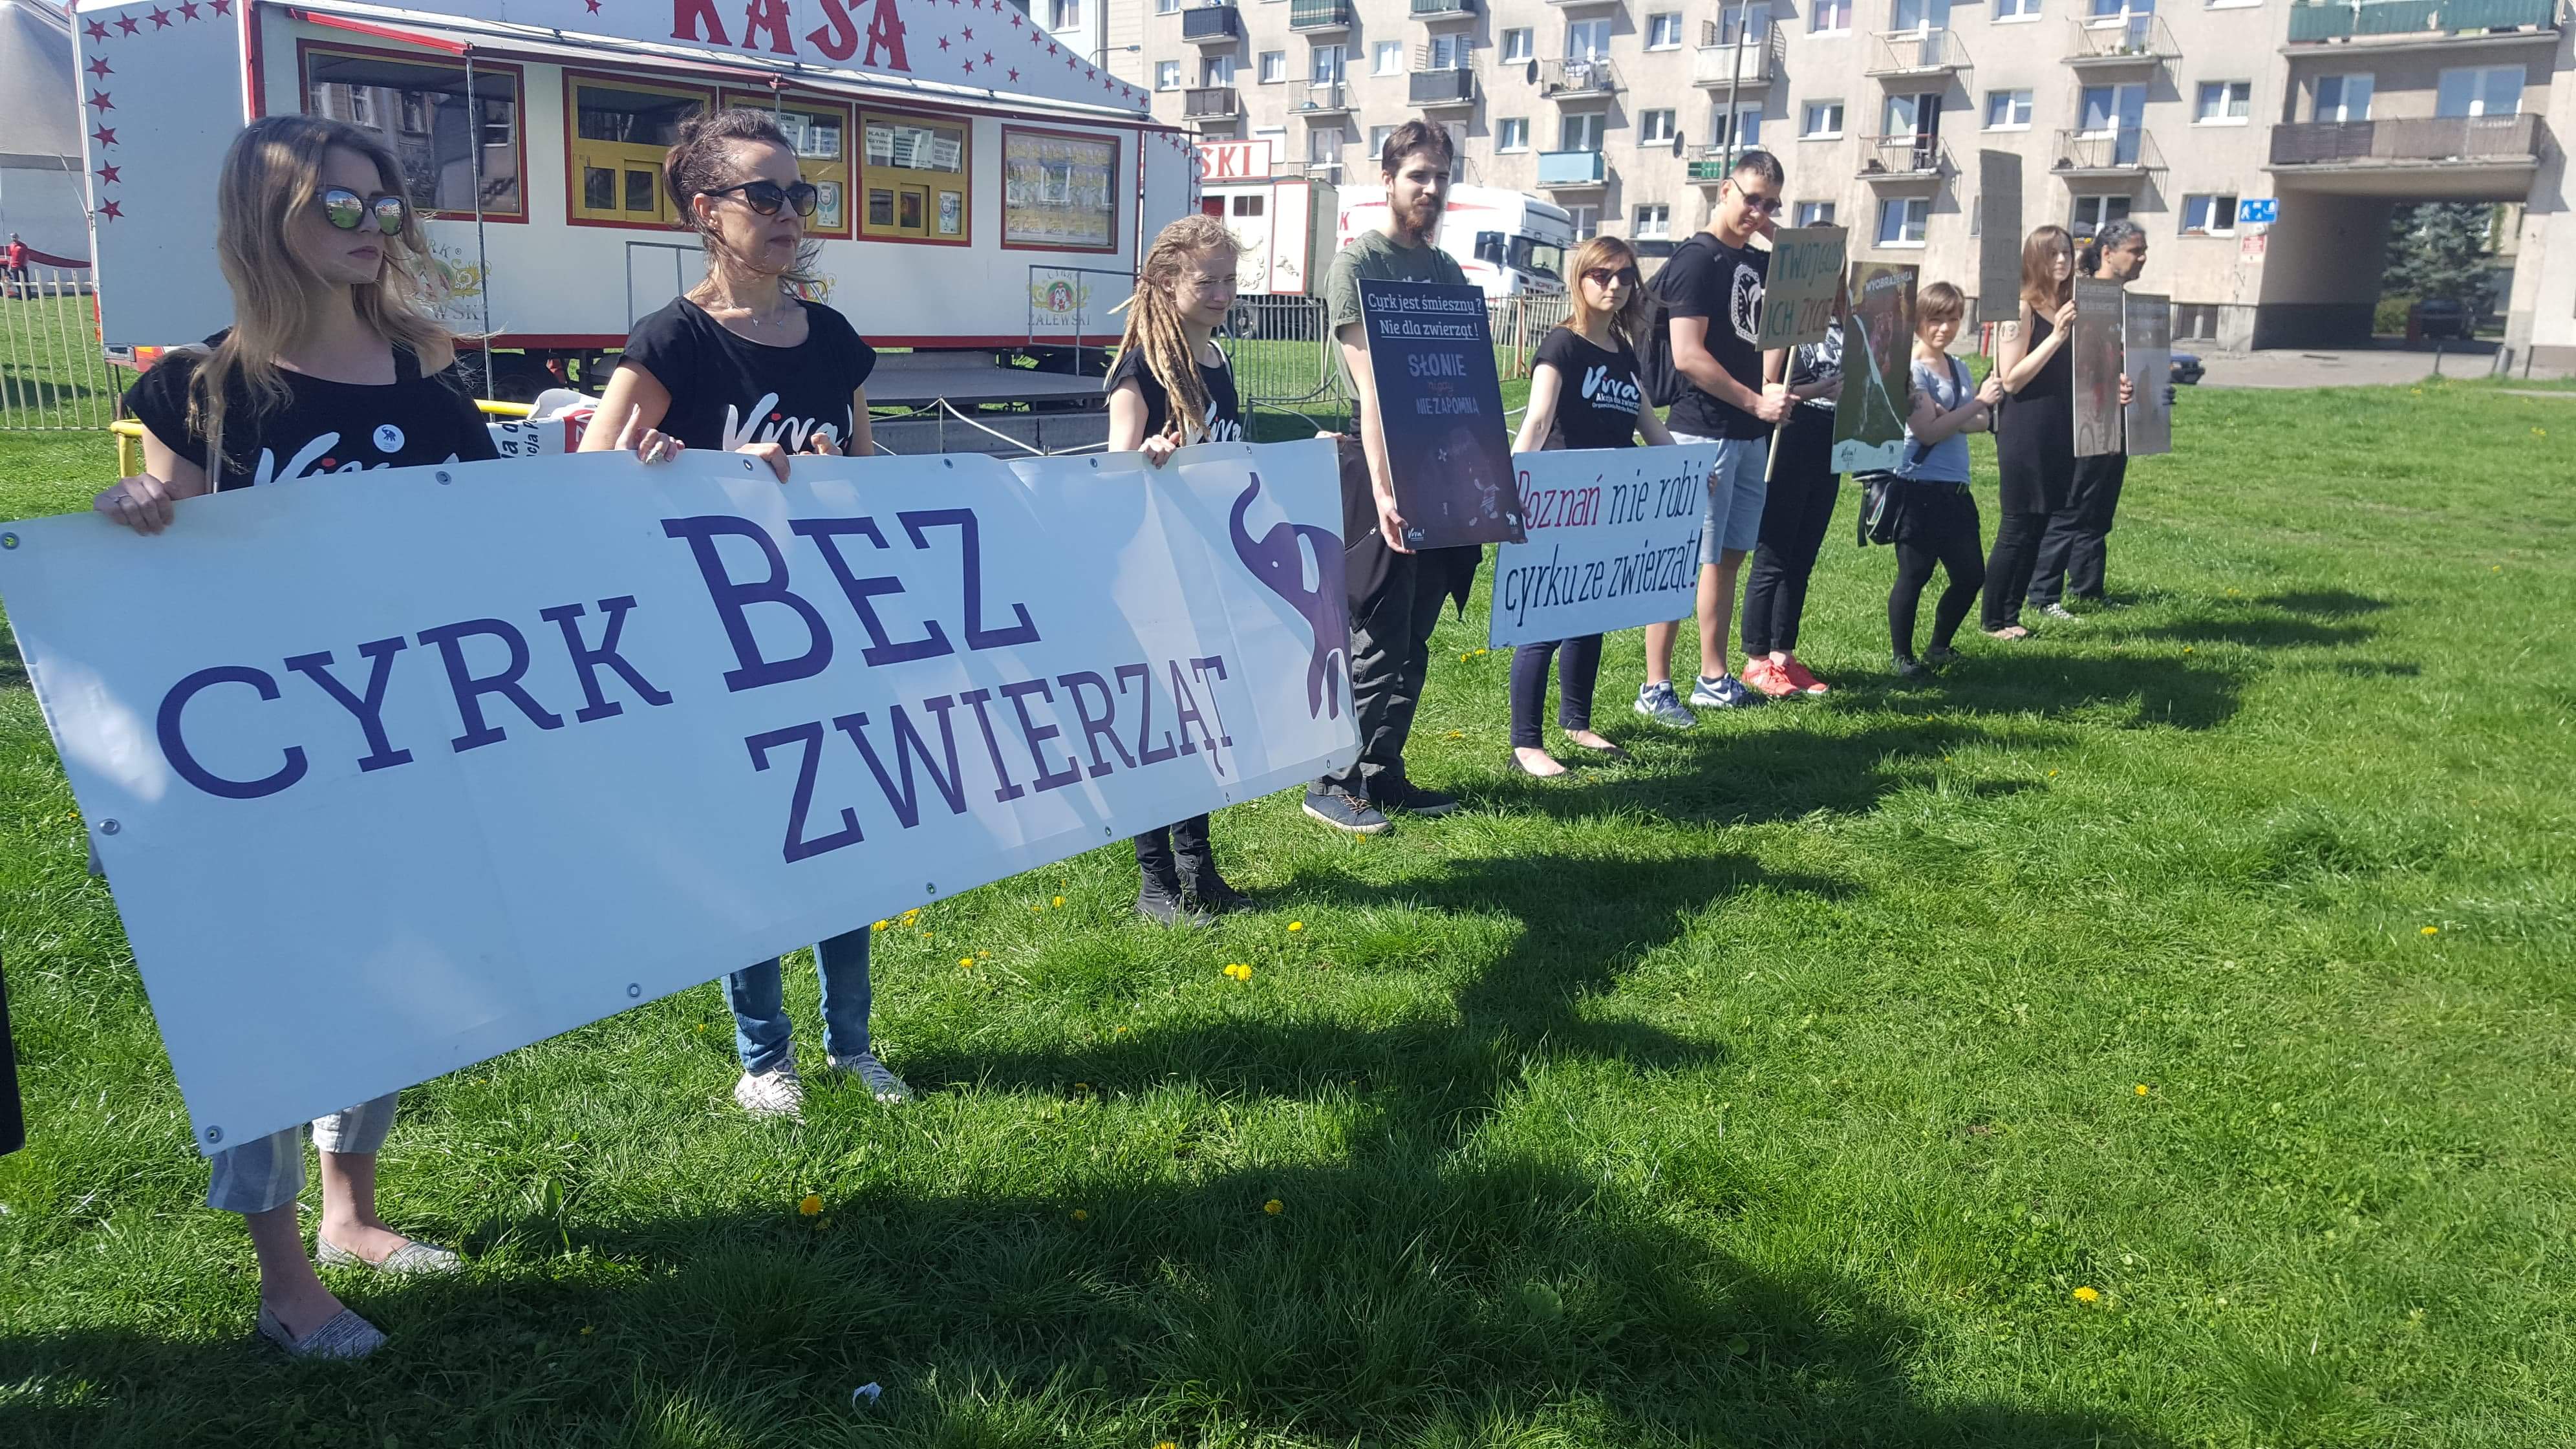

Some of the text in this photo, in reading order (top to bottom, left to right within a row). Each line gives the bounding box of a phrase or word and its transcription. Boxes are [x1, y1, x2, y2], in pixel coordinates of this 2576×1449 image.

[670, 0, 912, 72] KASA
[1368, 294, 1398, 310] Cyrk
[1398, 294, 1421, 312] jest
[1422, 294, 1475, 315] śmieszny
[1379, 319, 1401, 334] Nie
[1402, 321, 1421, 335] dla
[1422, 322, 1473, 339] zwierząt
[1766, 299, 1795, 339] ICH
[1408, 354, 1467, 377] SŁONIE
[1519, 460, 1702, 530] Poznań nie robi
[1505, 543, 1578, 627] cyrku
[1578, 560, 1604, 602] ze
[156, 508, 1041, 799] CYRK BEZ
[744, 655, 1234, 864] ZWIERZĄT
